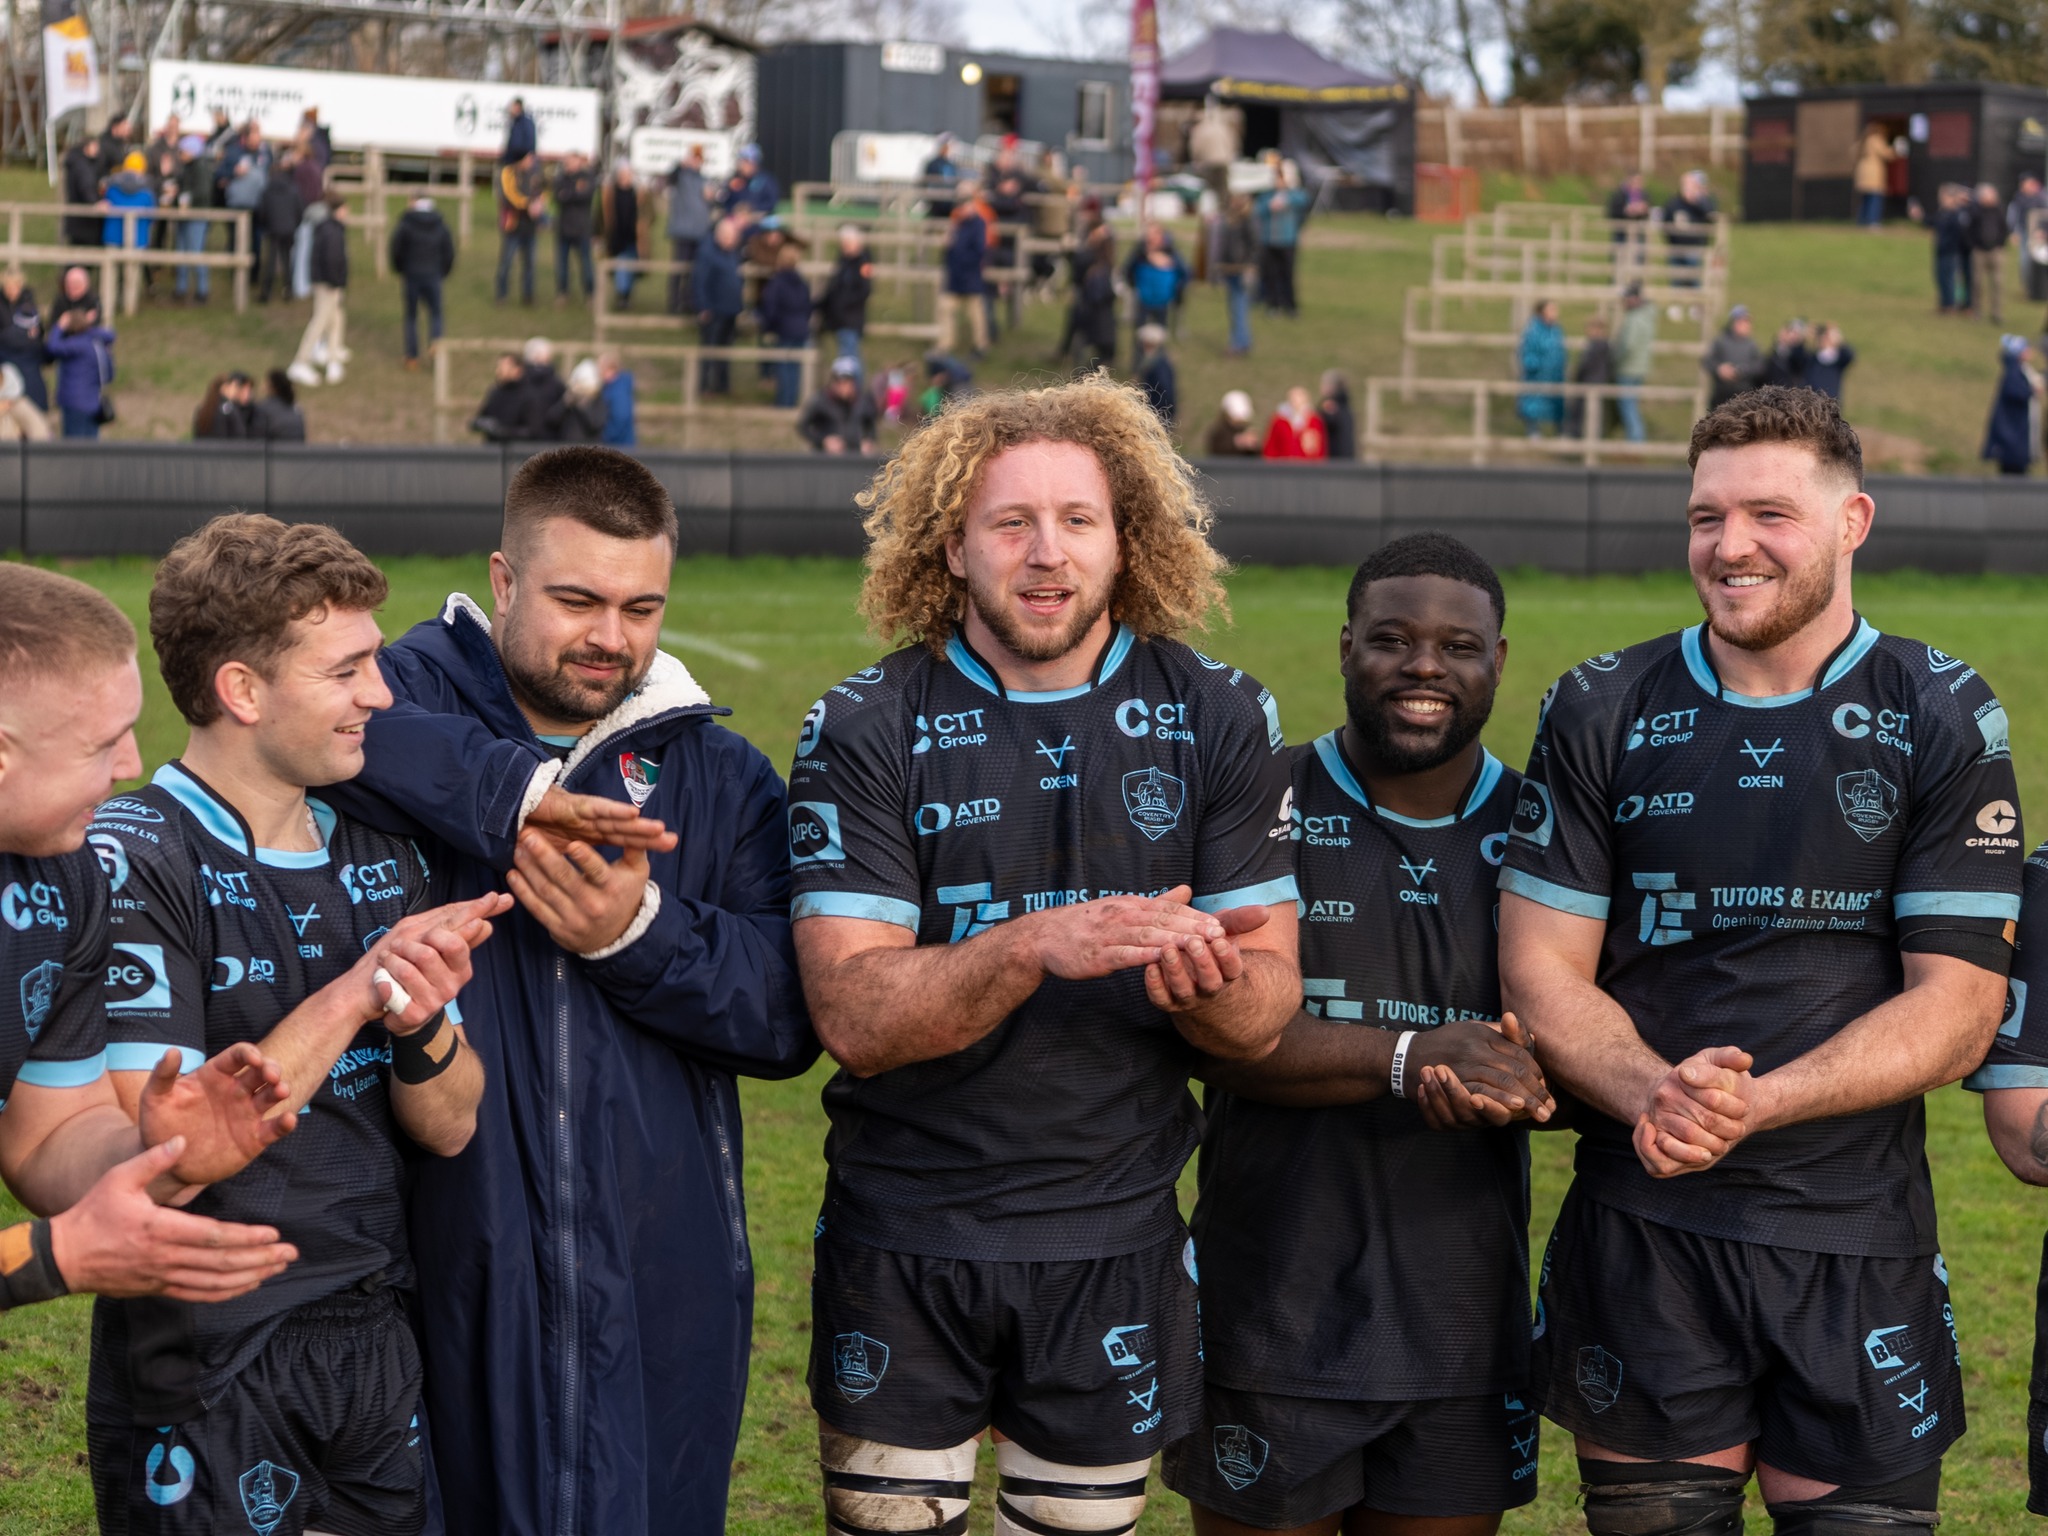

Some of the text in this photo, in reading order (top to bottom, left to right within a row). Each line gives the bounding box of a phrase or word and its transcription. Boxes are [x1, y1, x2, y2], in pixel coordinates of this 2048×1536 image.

[934, 708, 985, 734] CTT
[1155, 703, 1187, 725] CT
[1651, 707, 1700, 733] CTT
[1877, 708, 1911, 735] CT
[938, 732, 988, 750] Group
[1650, 730, 1694, 748] Group
[1040, 773, 1079, 791] OXEN
[1738, 775, 1784, 789] OXEN
[955, 797, 1001, 820] ATD
[1648, 792, 1695, 809] ATD
[955, 813, 1002, 828] COVENTRY
[1137, 811, 1171, 820] COVENTRY
[1647, 807, 1693, 817] COVENTRY
[1304, 814, 1351, 834] CTT
[138, 828, 160, 844] LTD
[1306, 834, 1351, 848] Group
[1965, 837, 2020, 849] CHAMP
[357, 859, 399, 887] CTT
[1399, 888, 1439, 905] OXEN
[1710, 887, 1785, 908] TUTORS
[1790, 888, 1805, 909] &
[1309, 900, 1355, 916] ATD
[1308, 915, 1354, 923] COVENTRY
[1712, 913, 1865, 932] Opening Learning Doors!
[104, 964, 145, 986] PG
[1376, 998, 1440, 1026] TUTORS
[1445, 1007, 1457, 1023] &
[1392, 1052, 1404, 1087] JESUS
[1131, 1407, 1163, 1435] OXEN
[1911, 1410, 1939, 1439] OXEN
[1512, 1458, 1537, 1481] OXEN
